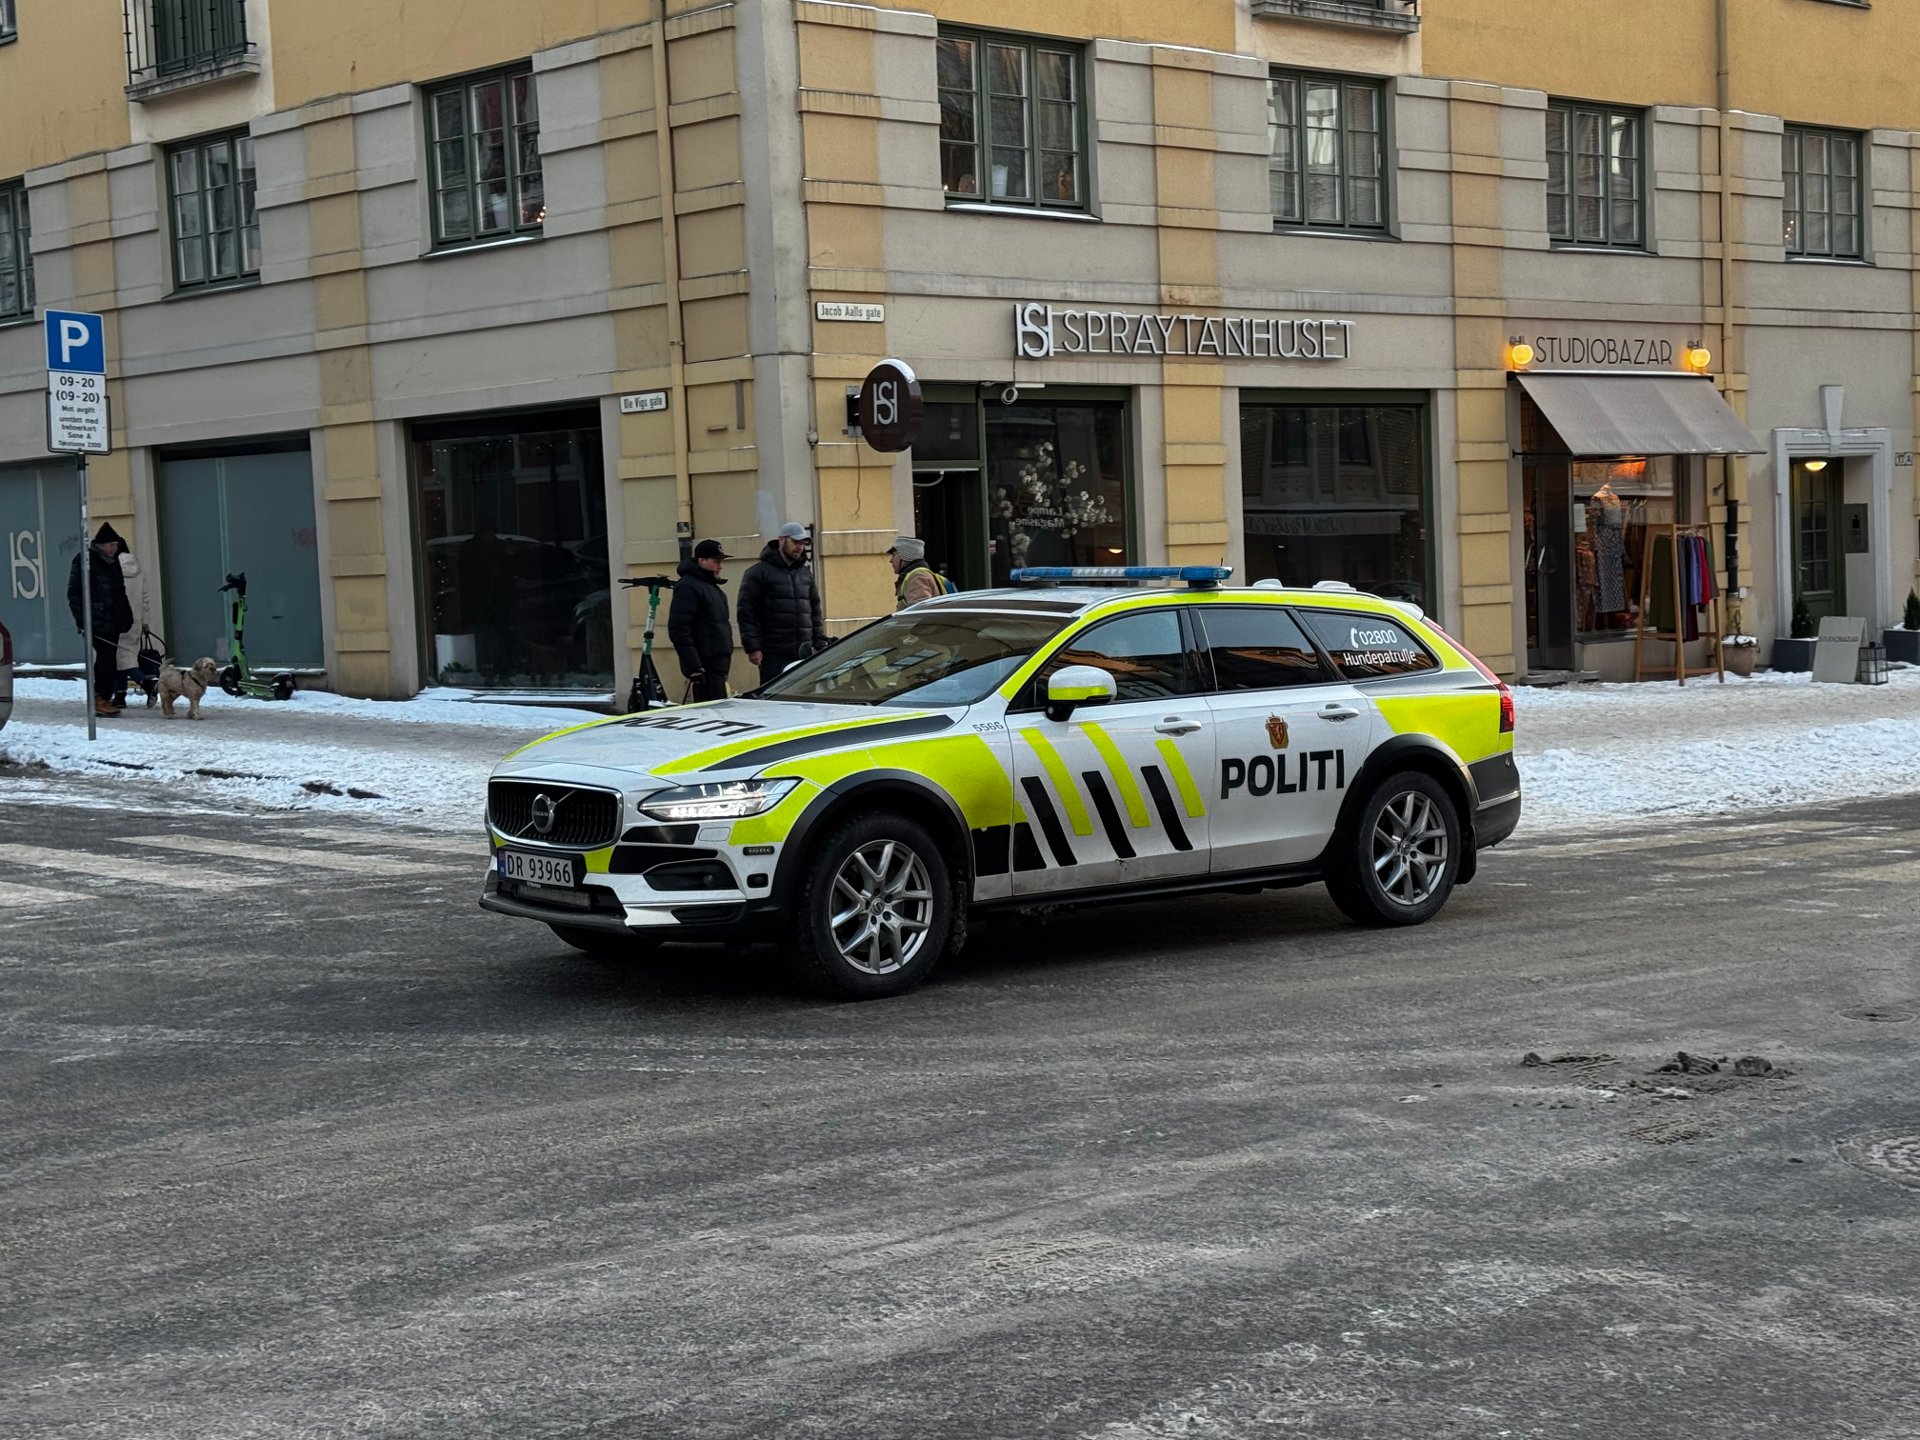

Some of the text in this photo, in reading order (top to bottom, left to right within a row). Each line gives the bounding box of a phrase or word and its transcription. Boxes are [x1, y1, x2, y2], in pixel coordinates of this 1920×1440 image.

[821, 304, 882, 320] Jacob Aalls gate
[60, 319, 90, 363] P
[1062, 309, 1355, 359] SPRAYTANHUSET
[1535, 336, 1672, 365] STUDIOBAZAR
[60, 375, 95, 388] 09-20
[56, 389, 100, 404] (09-20)
[1358, 629, 1398, 645] 02800
[1342, 648, 1417, 667] Hundepatrulje
[972, 721, 1004, 732] 5566
[1220, 748, 1345, 800] POLITI
[506, 854, 571, 884] DR 93966
